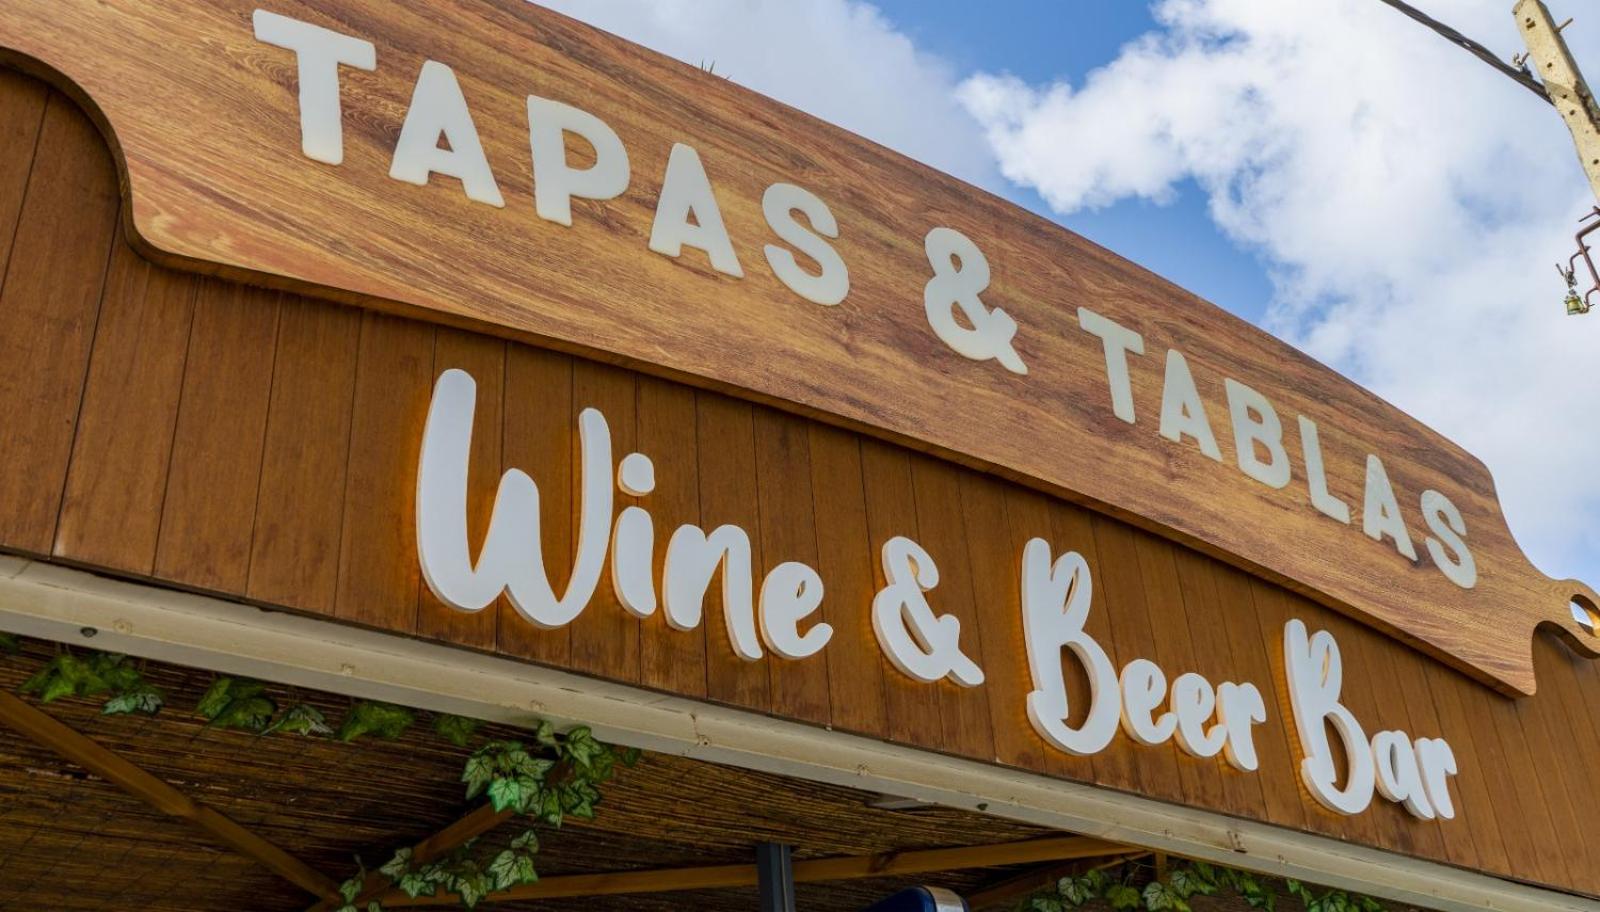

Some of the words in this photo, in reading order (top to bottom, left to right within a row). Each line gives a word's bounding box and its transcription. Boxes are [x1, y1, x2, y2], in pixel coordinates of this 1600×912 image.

[252, 8, 850, 307] TAPAS
[923, 226, 1028, 375] &
[1077, 306, 1478, 589] TABLAS
[416, 368, 834, 661] Wine
[872, 536, 985, 687] &
[1022, 537, 1267, 772] Beer
[1284, 618, 1458, 821] Bar
